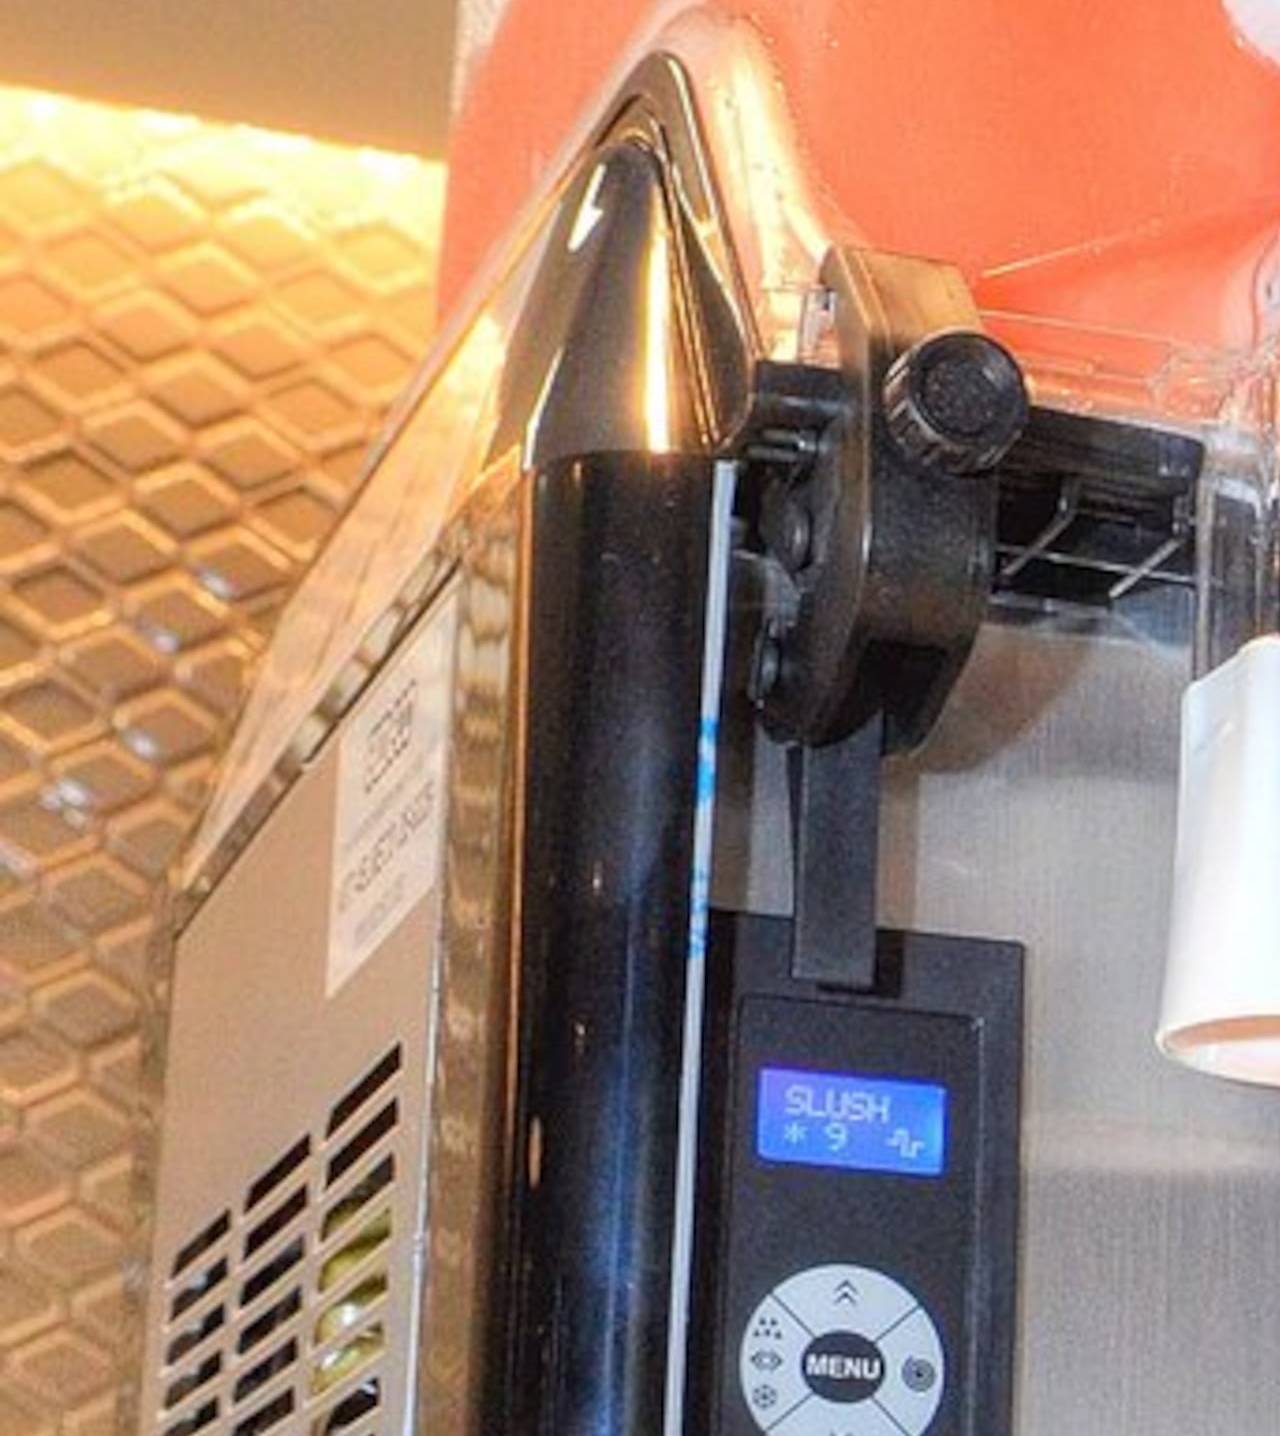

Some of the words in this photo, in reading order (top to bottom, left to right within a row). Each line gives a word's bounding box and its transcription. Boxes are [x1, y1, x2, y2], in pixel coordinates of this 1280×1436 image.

[784, 1083, 891, 1123] SLUSH
[825, 1121, 847, 1152] 9
[807, 1353, 880, 1379] MENU
